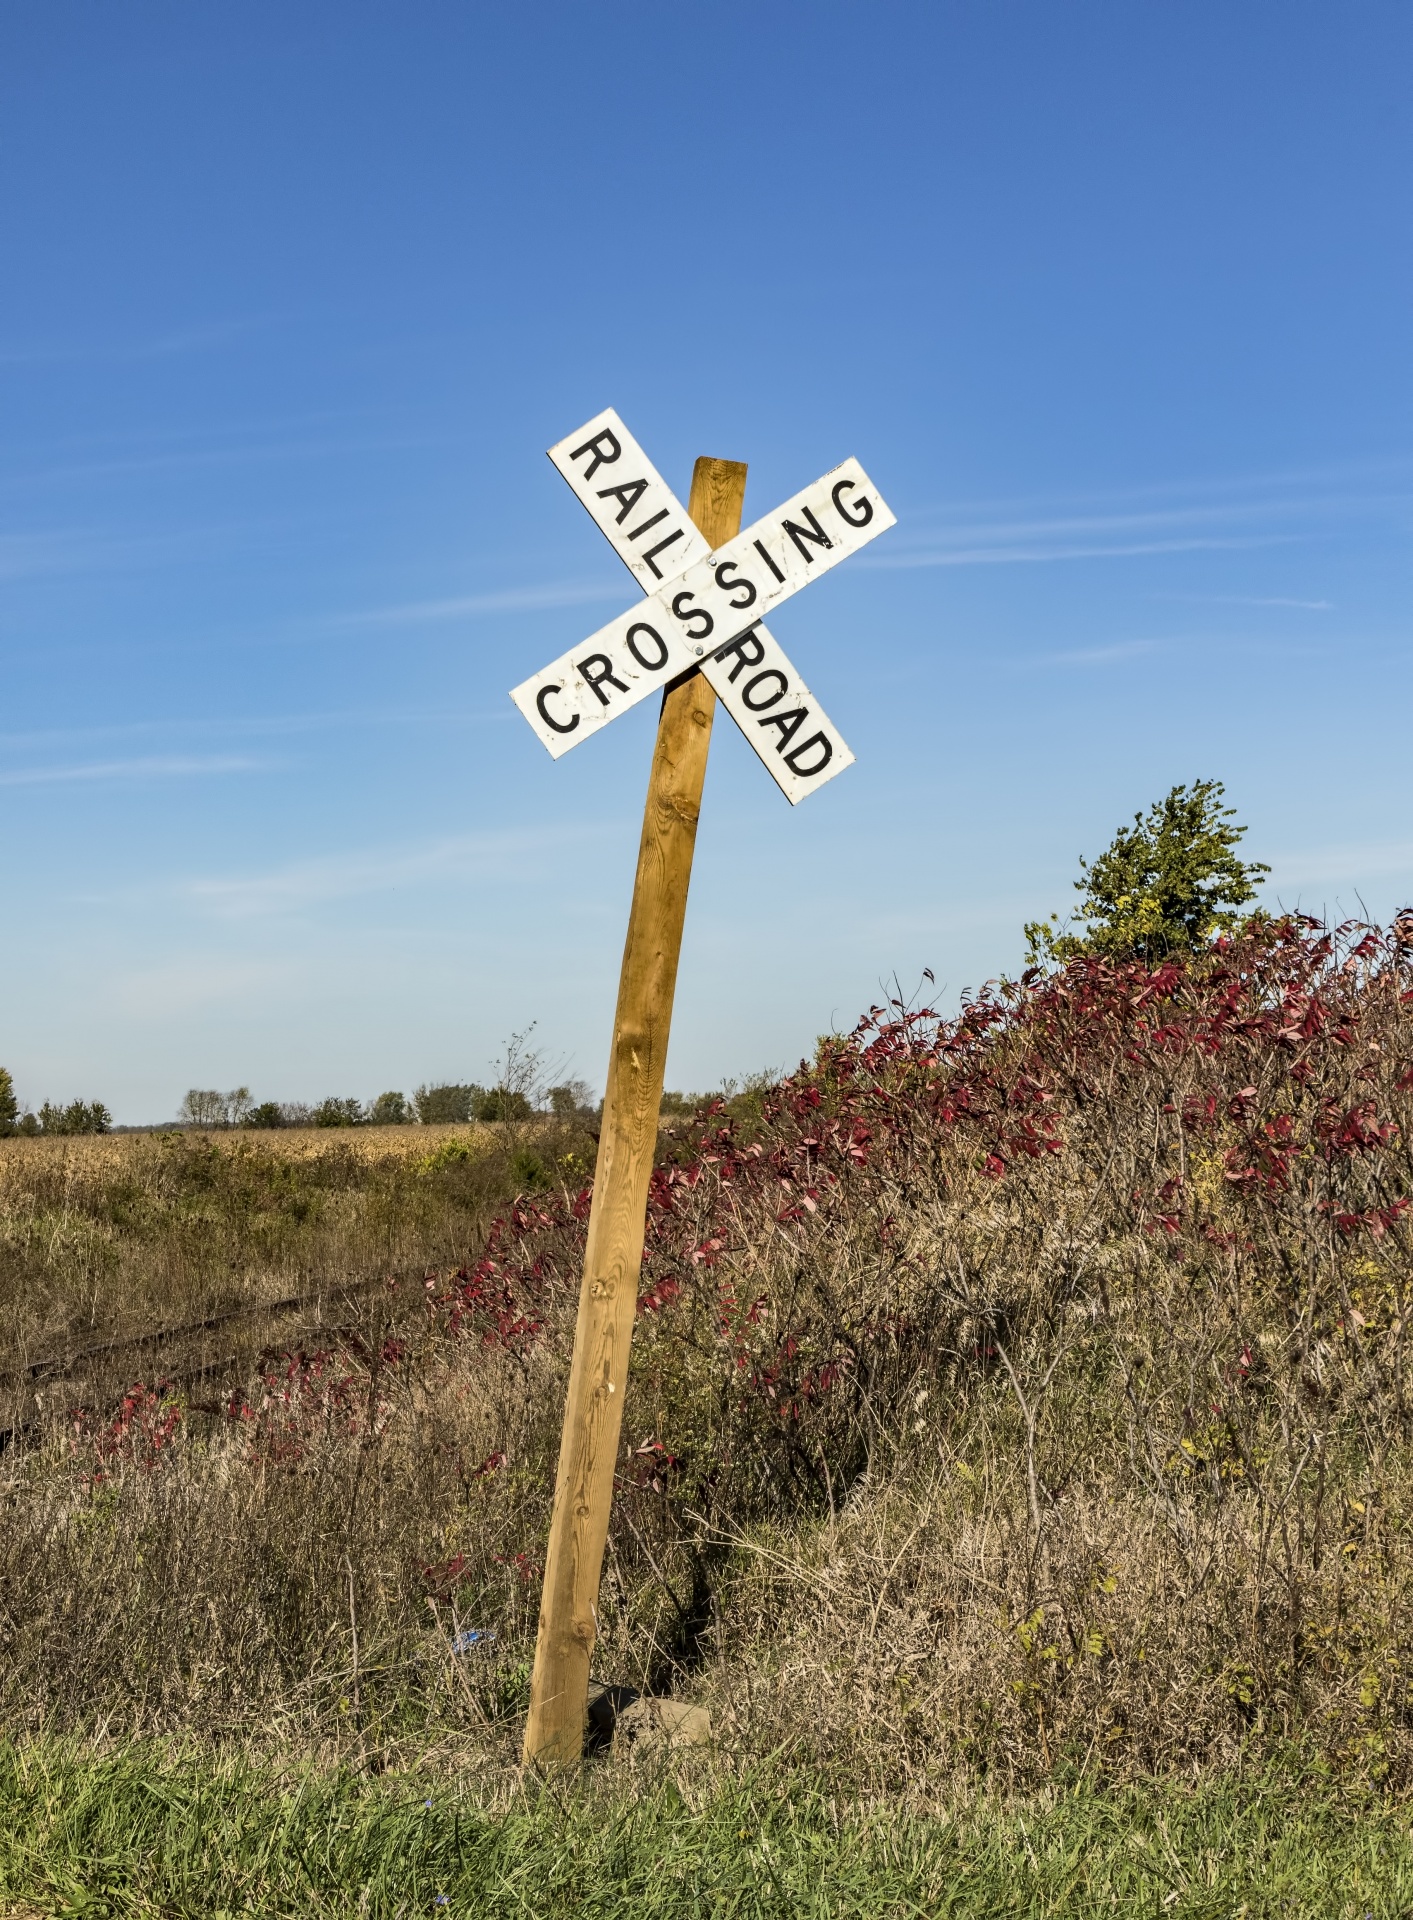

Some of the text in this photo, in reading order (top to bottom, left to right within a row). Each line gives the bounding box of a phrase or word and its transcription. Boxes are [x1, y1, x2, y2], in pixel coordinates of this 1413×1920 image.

[536, 480, 874, 734] CROSSING
[570, 428, 833, 777] RAIL ROAD
